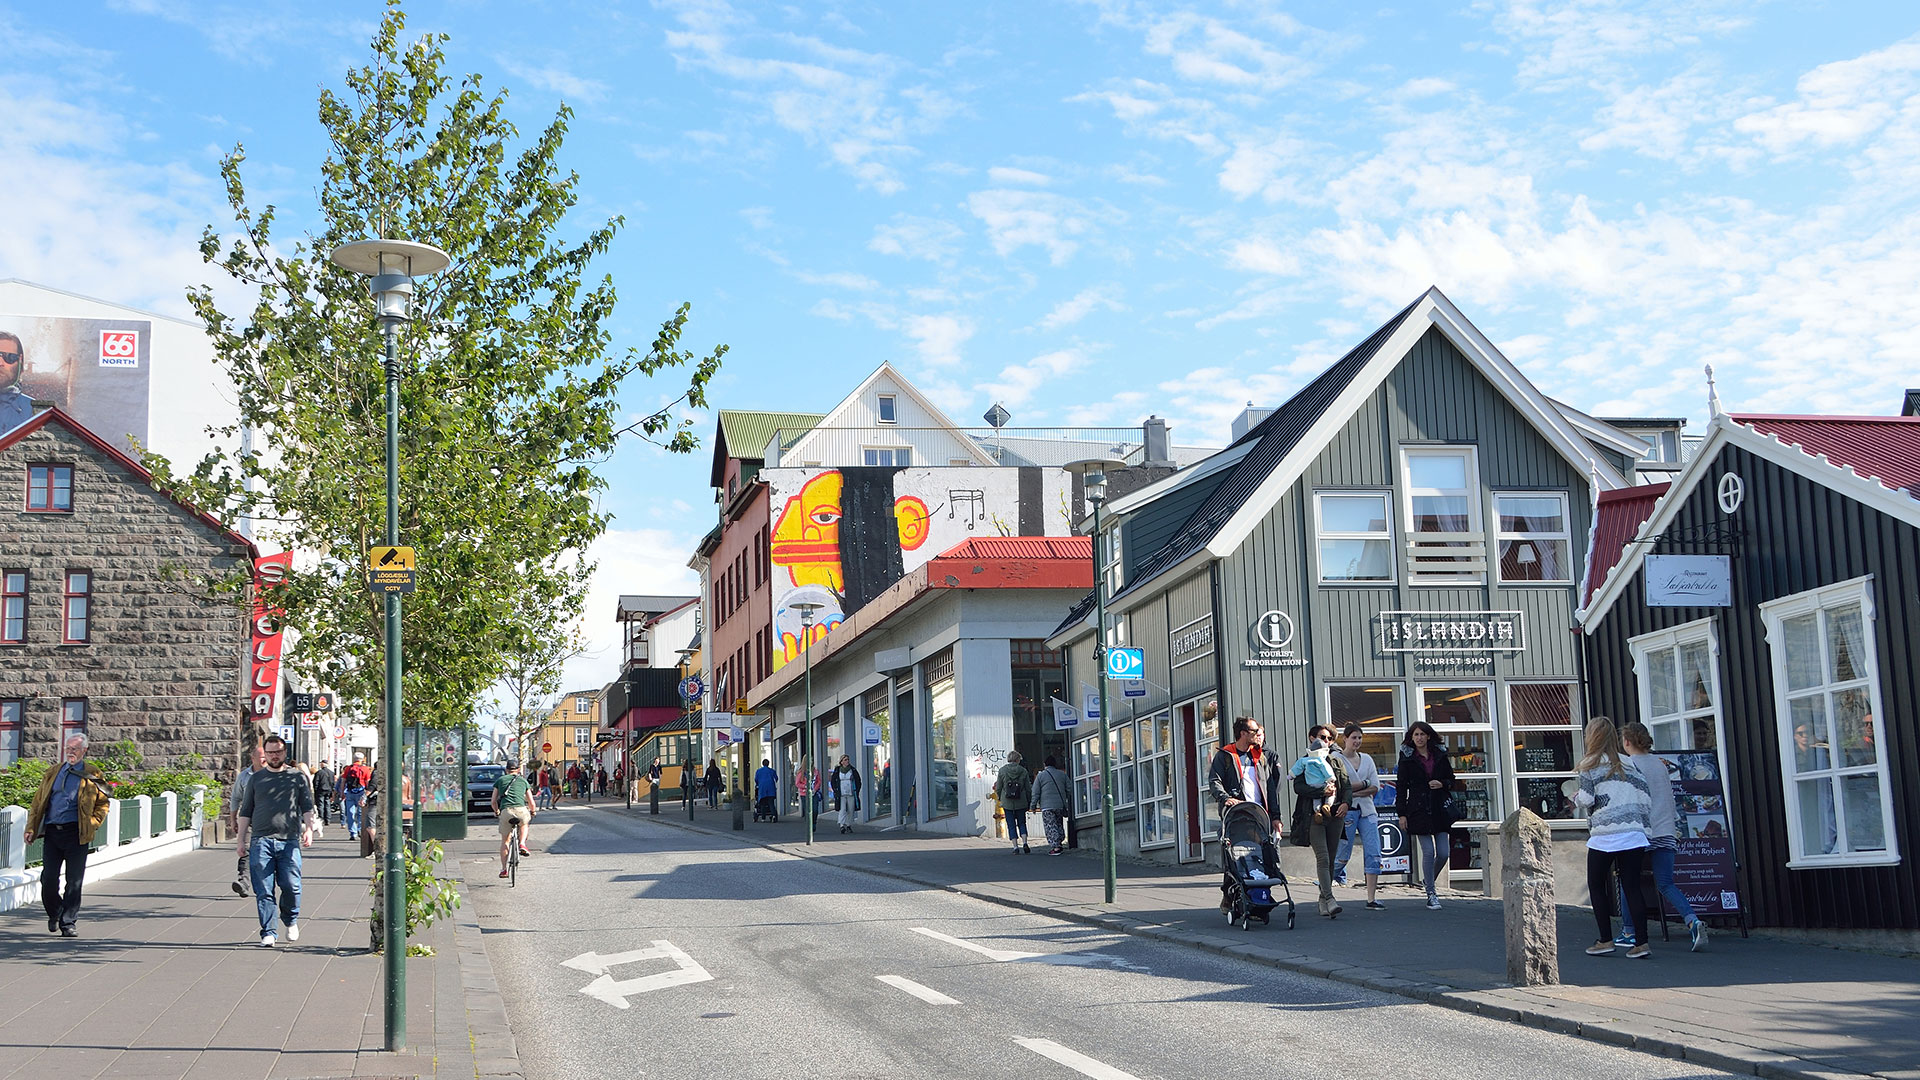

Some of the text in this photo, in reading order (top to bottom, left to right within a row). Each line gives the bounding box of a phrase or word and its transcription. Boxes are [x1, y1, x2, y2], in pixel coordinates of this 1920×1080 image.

[1391, 621, 1514, 641] ISLANDIA
[1173, 624, 1212, 658] ISLANDIA
[1259, 650, 1295, 658] TOURIST
[1245, 659, 1302, 667] INFORMATION
[1418, 657, 1493, 665] TOURIST SHOP
[296, 696, 309, 707] b5
